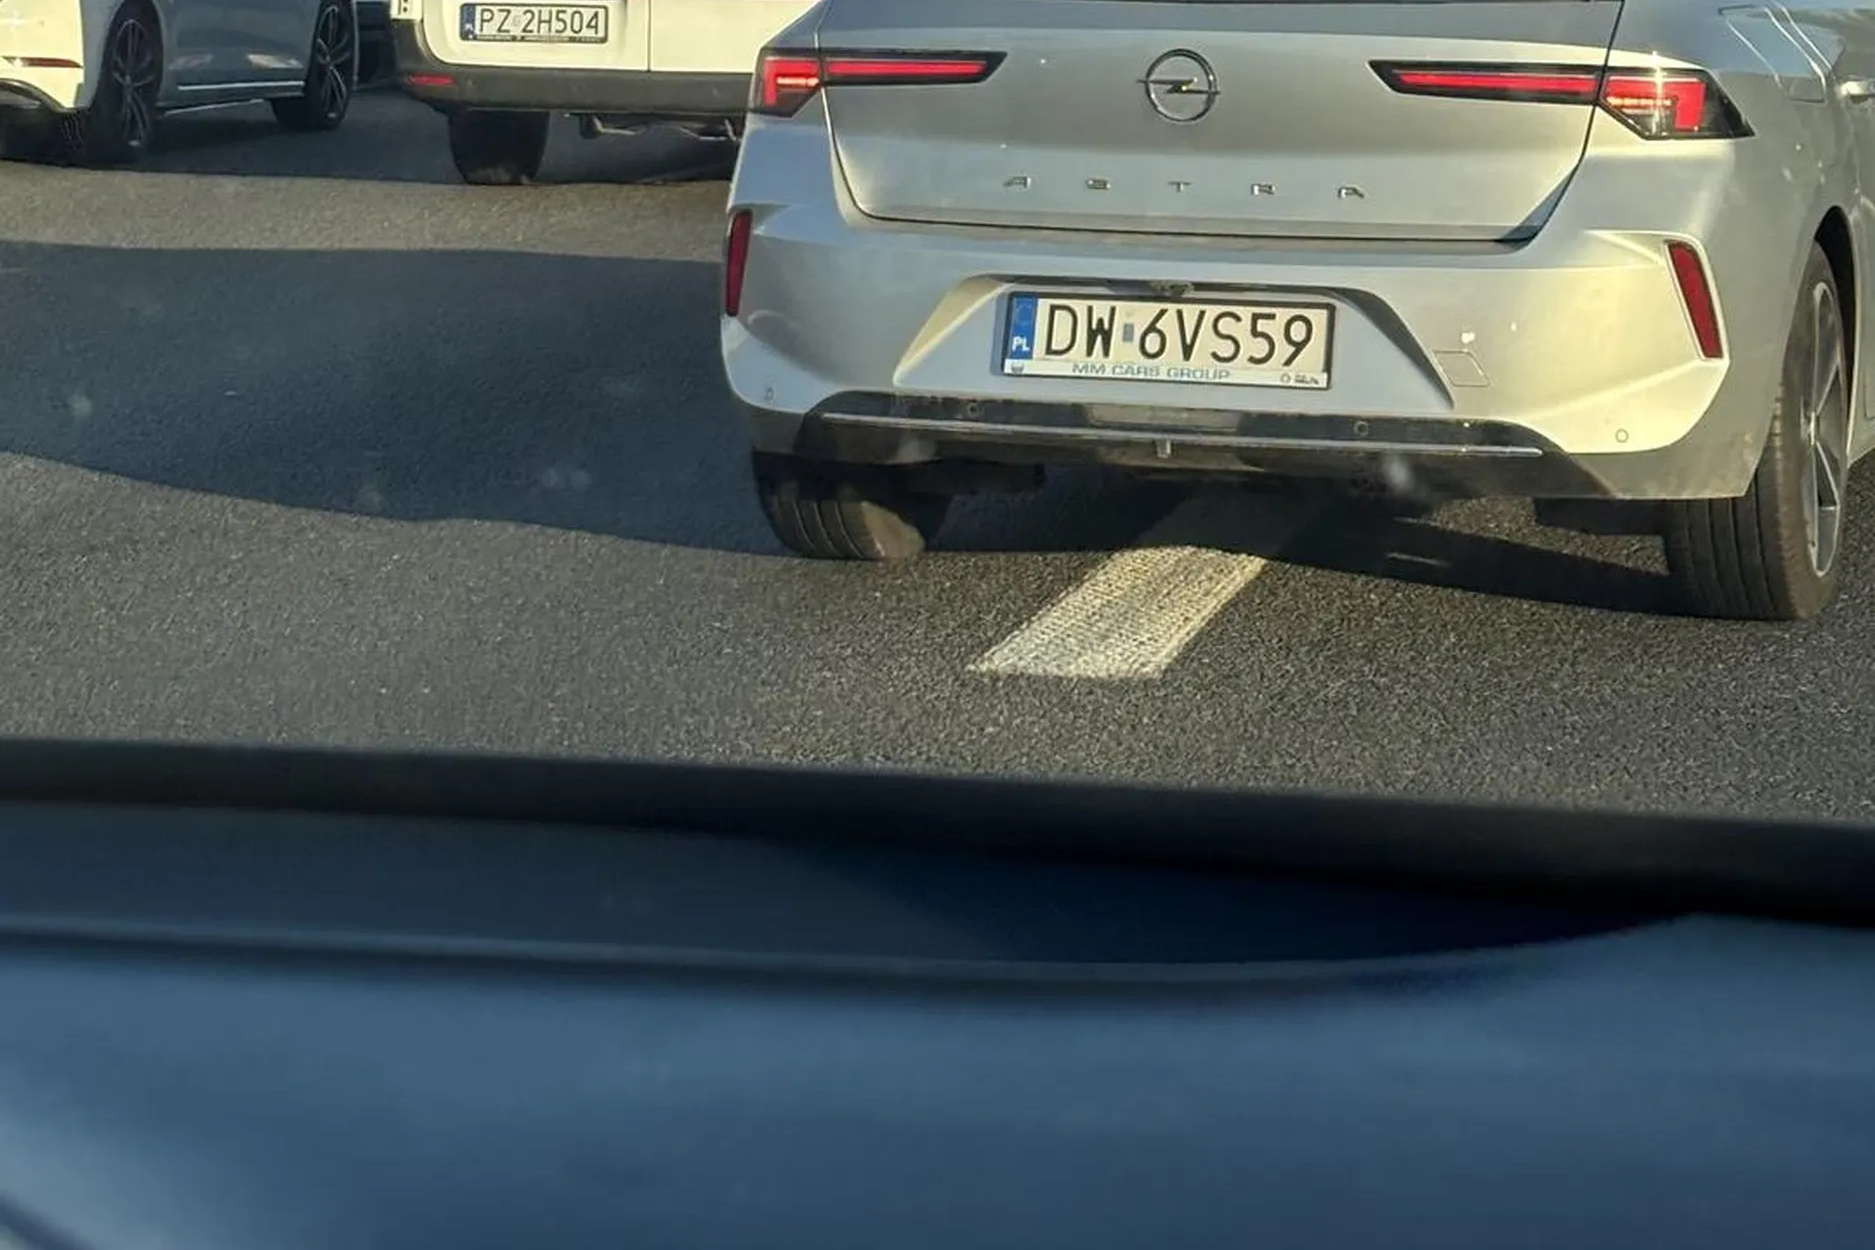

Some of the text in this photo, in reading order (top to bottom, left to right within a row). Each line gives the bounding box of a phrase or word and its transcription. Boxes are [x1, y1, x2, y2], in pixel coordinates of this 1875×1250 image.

[479, 8, 599, 35] PZ 2H504
[1003, 175, 1365, 199] ASTRA
[1012, 336, 1031, 352] PL
[1044, 303, 1314, 368] DW 6VS59
[1072, 363, 1106, 376] MM
[1166, 367, 1230, 382] GROUP
